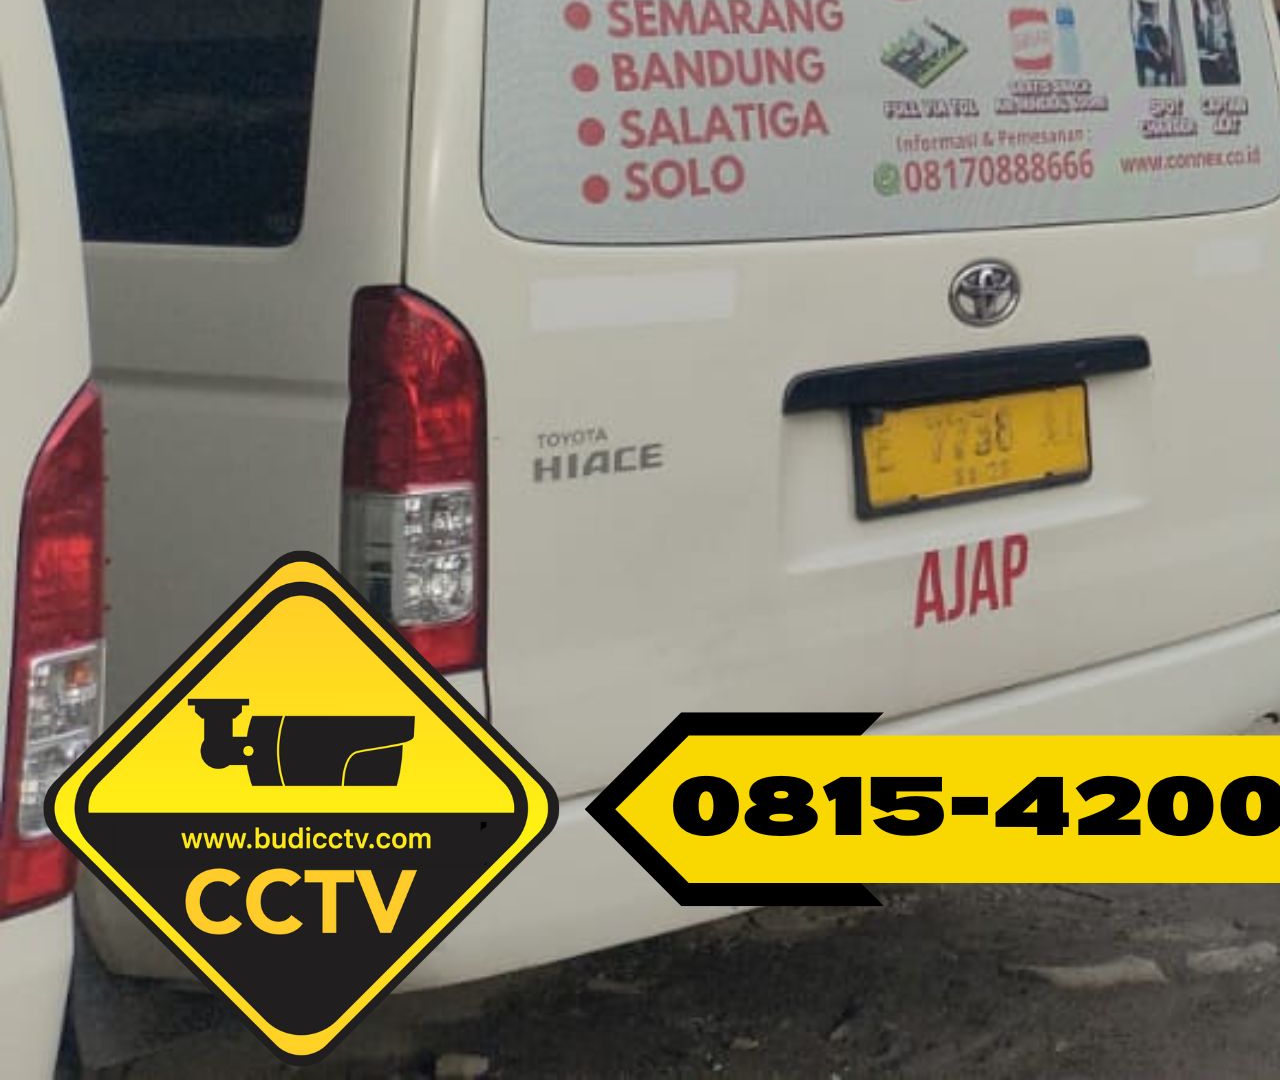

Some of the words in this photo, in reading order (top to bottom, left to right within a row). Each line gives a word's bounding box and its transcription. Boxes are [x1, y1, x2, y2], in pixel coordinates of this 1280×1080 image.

[611, 46, 825, 92] BANDUNG
[619, 100, 829, 149] SALATIGA
[896, 134, 977, 152] Informasi
[999, 129, 1083, 146] Pemesanan
[624, 155, 746, 202] SOLO
[903, 149, 1094, 192] 08170888666
[1120, 146, 1261, 174] www.connex.co.id
[537, 429, 608, 448] TOYOTA
[533, 443, 664, 483] HIACE
[914, 534, 1028, 629] AJAP
